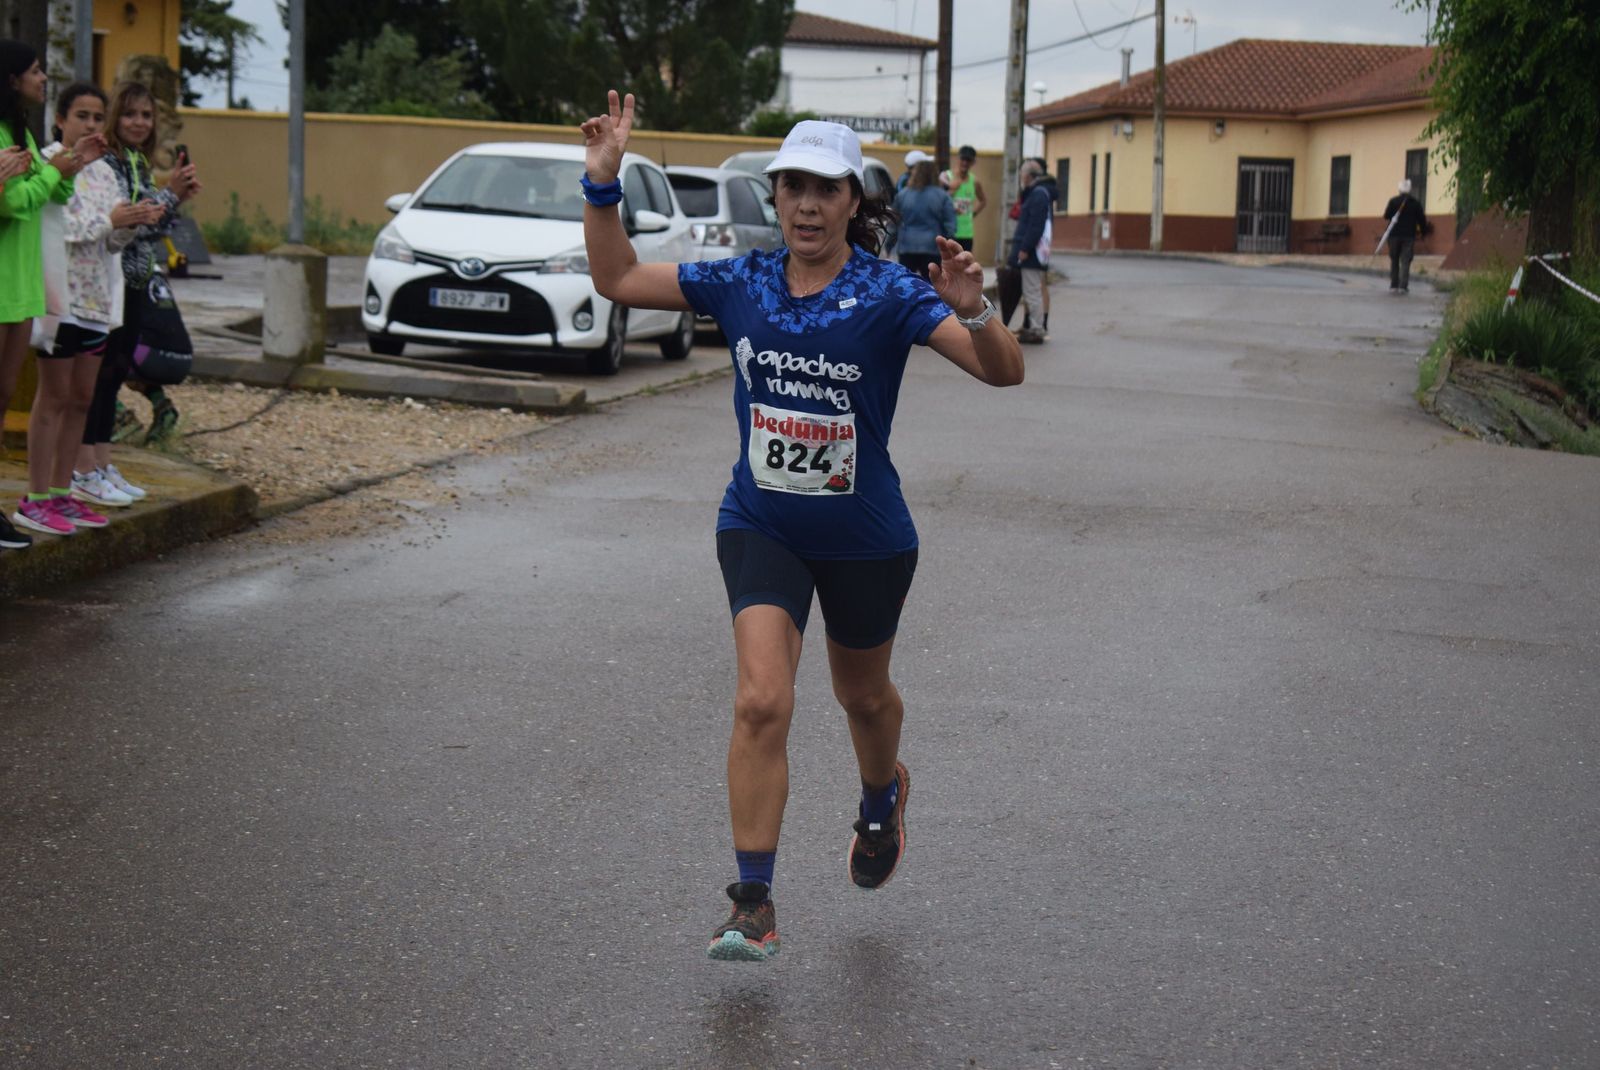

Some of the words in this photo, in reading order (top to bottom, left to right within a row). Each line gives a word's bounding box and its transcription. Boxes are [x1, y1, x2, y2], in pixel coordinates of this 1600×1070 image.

[440, 290, 476, 306] 8927
[757, 350, 862, 382] apaches
[766, 377, 851, 411] running
[753, 407, 854, 441] bedunia
[766, 438, 832, 474] 824
